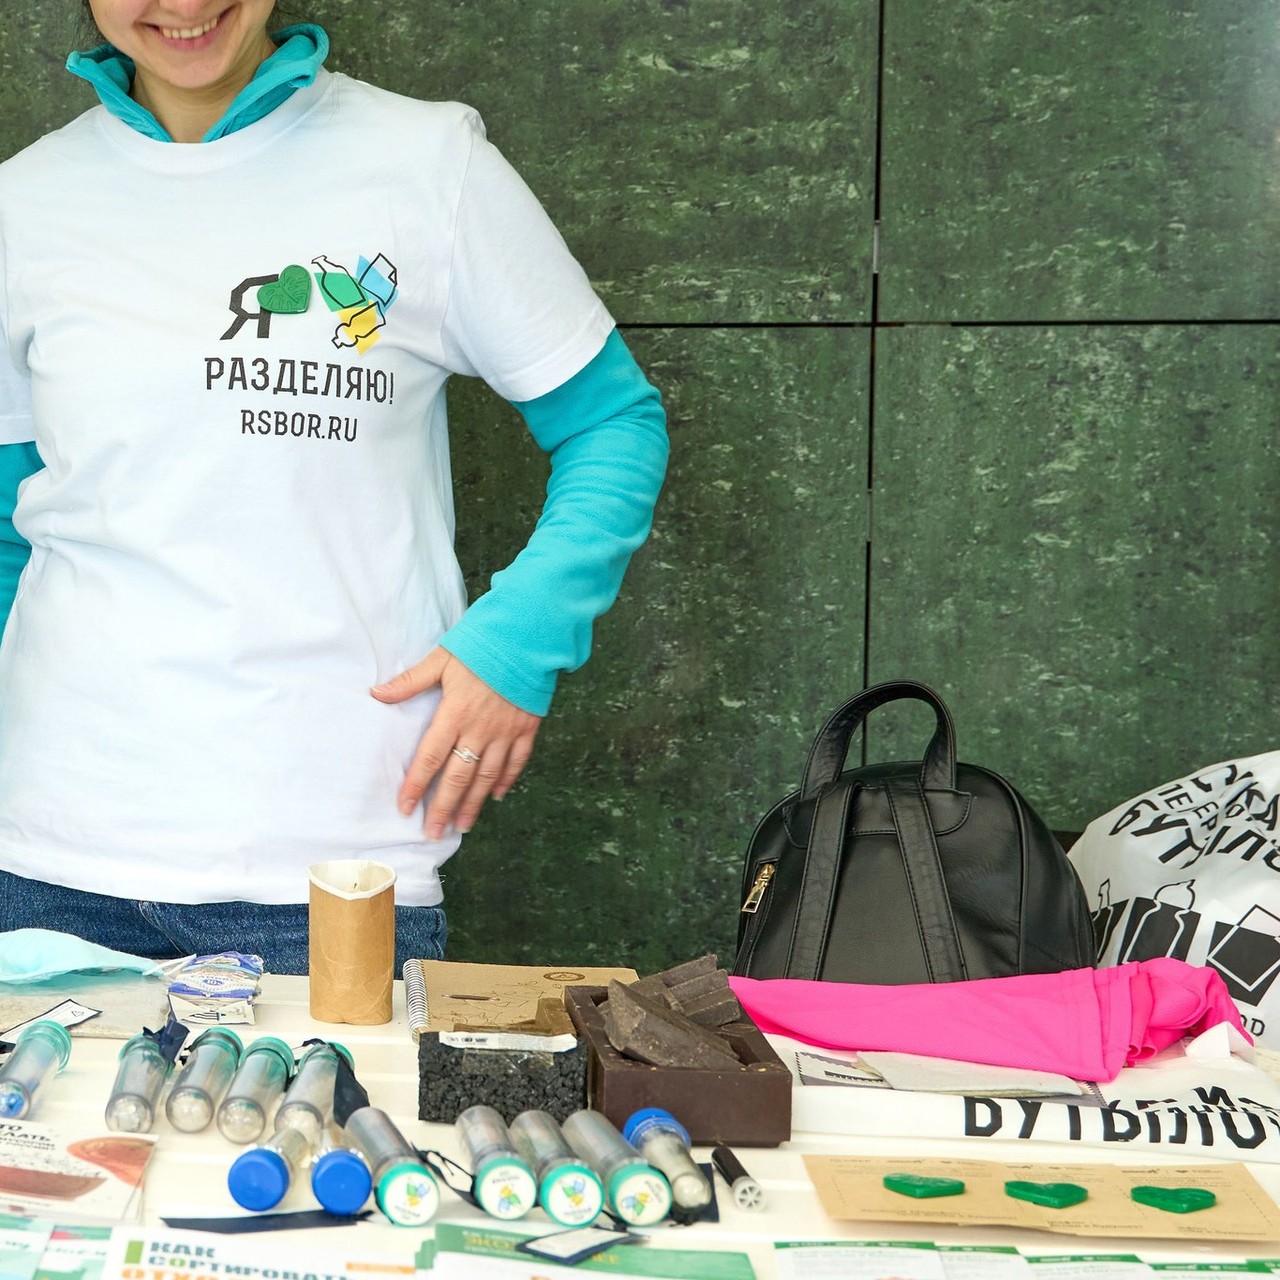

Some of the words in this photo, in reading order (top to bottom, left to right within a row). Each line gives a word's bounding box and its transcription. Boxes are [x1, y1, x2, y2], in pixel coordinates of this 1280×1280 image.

[204, 357, 394, 405] РАЗДЕЛЯЮ!
[240, 409, 357, 442] RSBOR.RU
[150, 1241, 216, 1258] КАК
